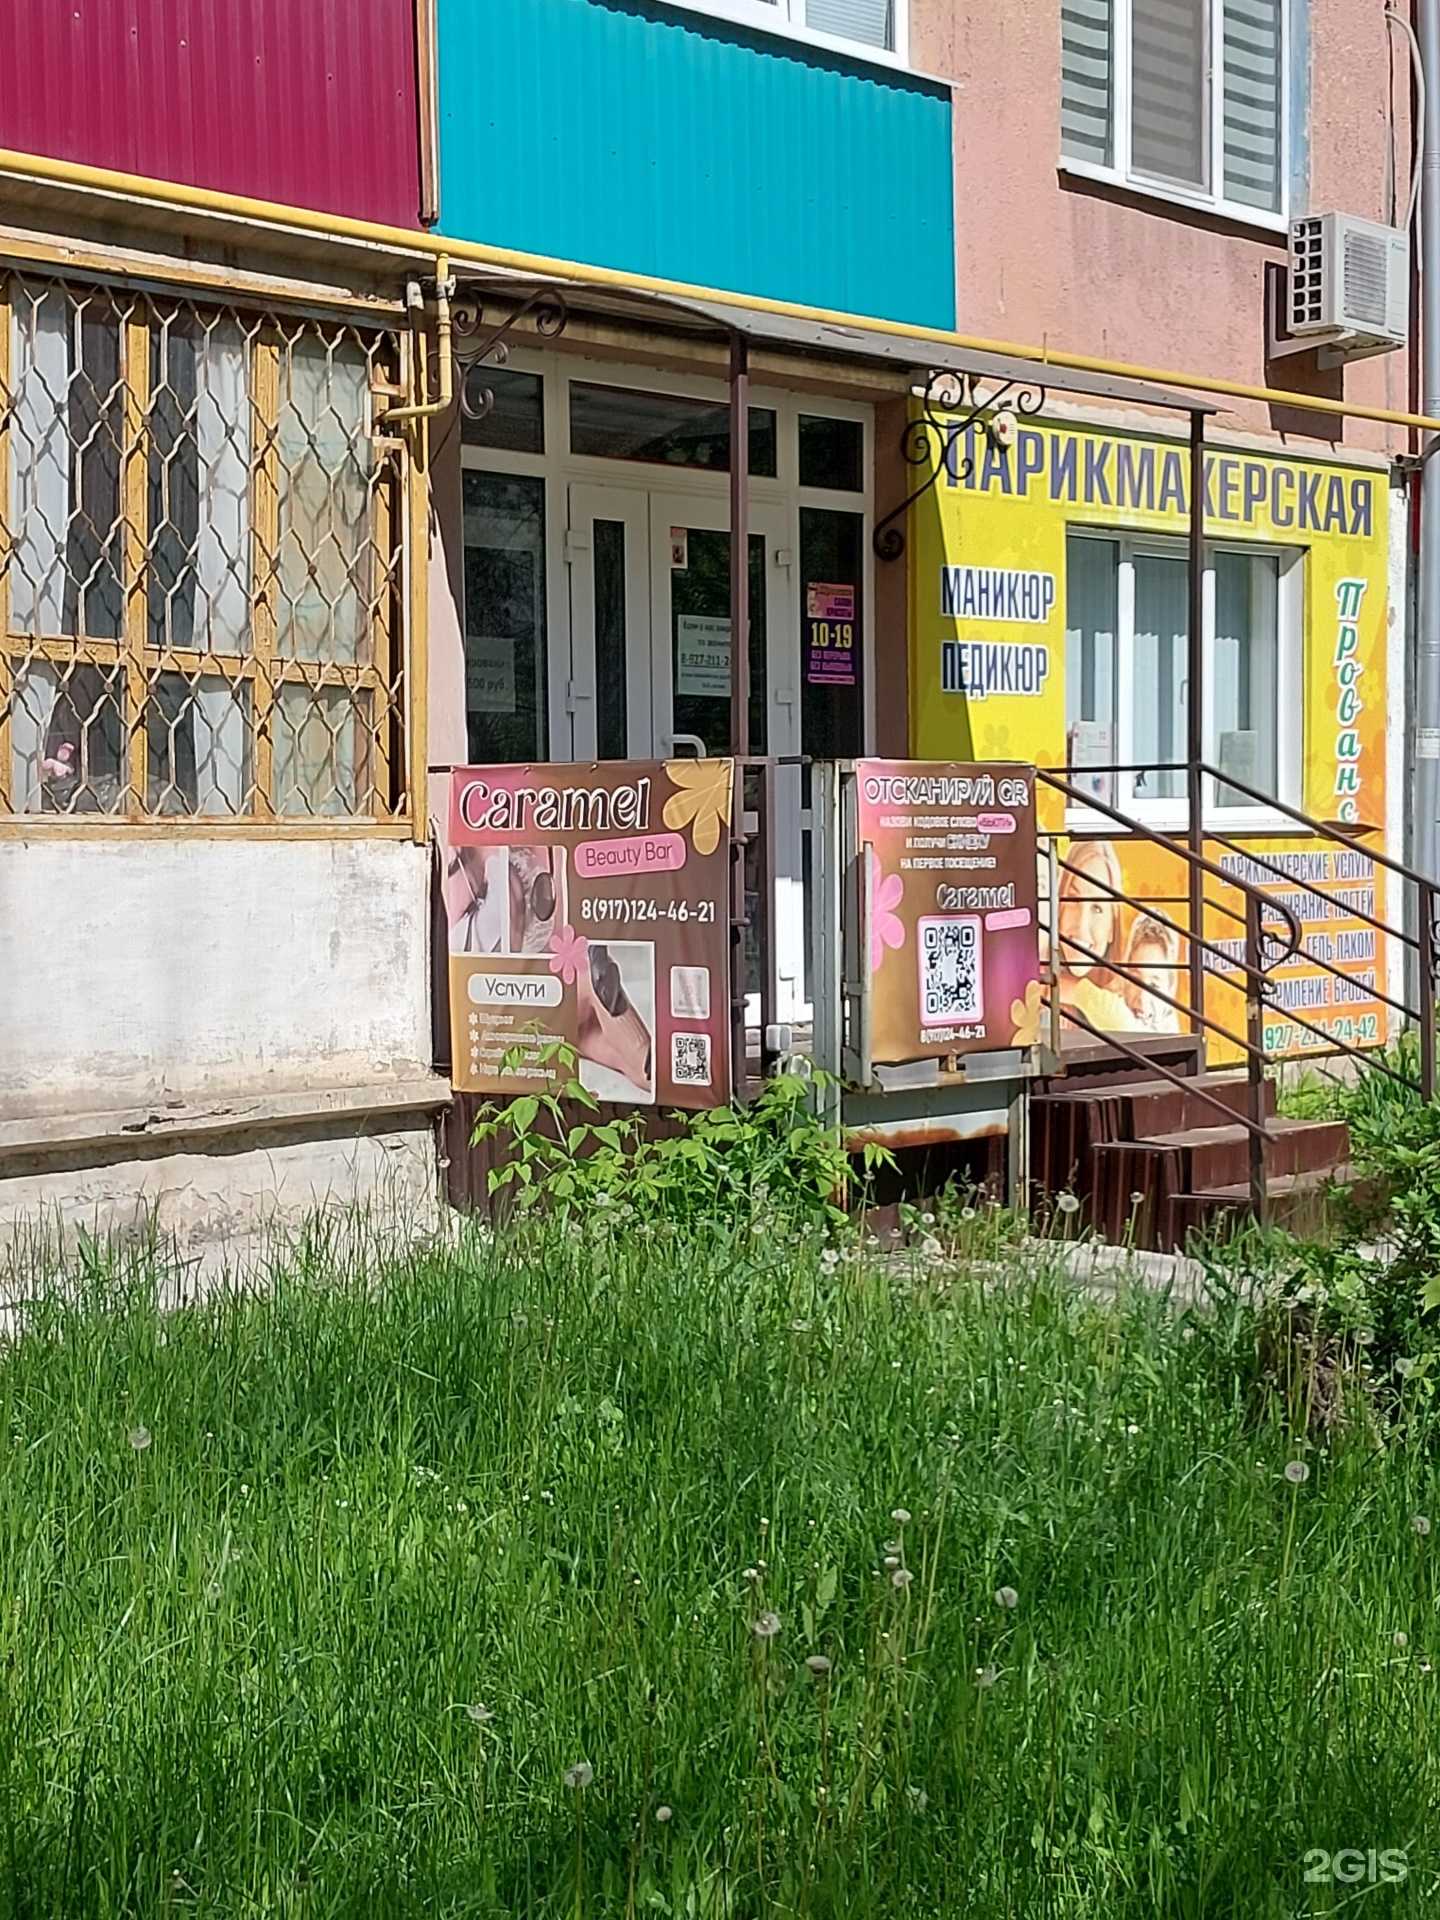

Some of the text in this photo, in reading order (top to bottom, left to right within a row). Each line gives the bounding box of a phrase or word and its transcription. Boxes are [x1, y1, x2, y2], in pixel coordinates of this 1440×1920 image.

[946, 418, 1373, 537] ПАРИКМАХЕРСКАЯ
[942, 568, 1054, 620] МАНИКЮР
[811, 622, 853, 649] 10-19
[942, 642, 1048, 696] ПЕДИКЮР
[459, 777, 651, 831] Caramel
[864, 774, 995, 806] ОТСКАНИРУЙ
[586, 841, 673, 867] Beauty Bar
[580, 899, 715, 924] 8(917)124-46-21
[936, 882, 1016, 909] Caramel
[1261, 890, 1329, 923] РАЩИВАНИЕ
[485, 977, 546, 1000] Услуги
[1272, 976, 1329, 1008] РМЛЕНИЕ
